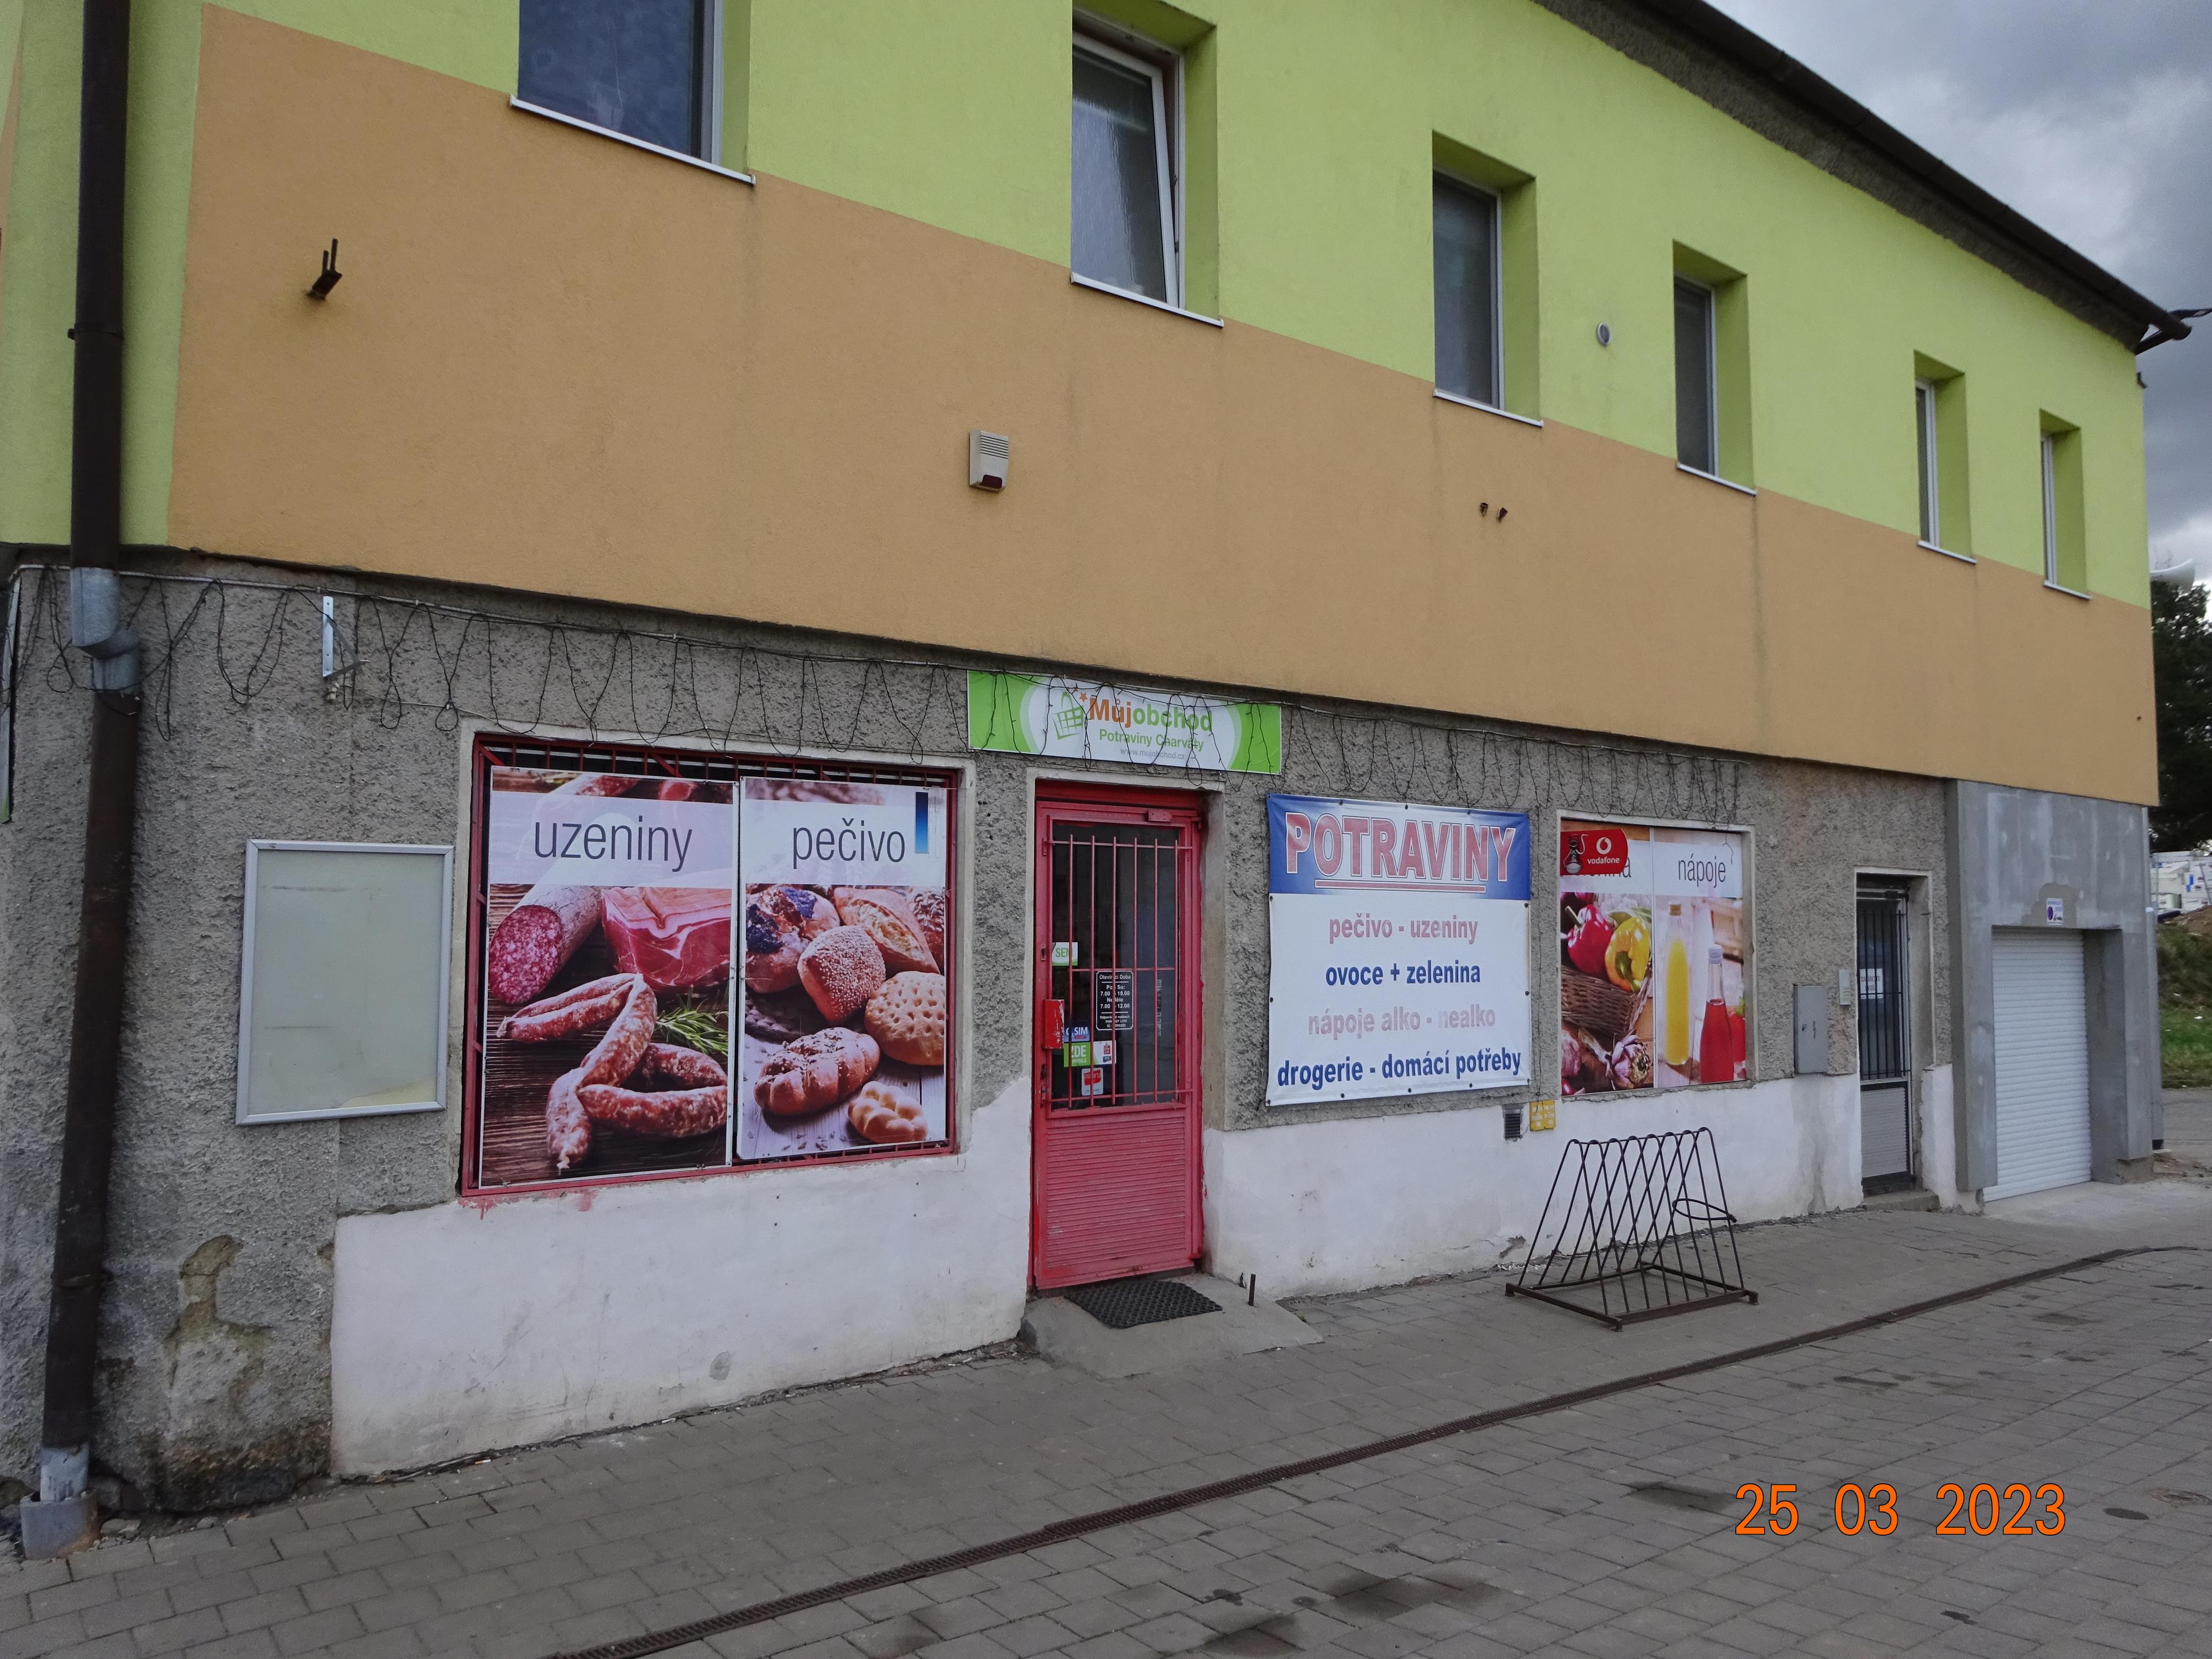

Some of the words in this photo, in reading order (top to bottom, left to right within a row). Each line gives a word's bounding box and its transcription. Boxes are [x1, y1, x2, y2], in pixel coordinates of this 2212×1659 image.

[1089, 697, 1213, 732] Můjobchod
[1099, 728, 1152, 747] Potraviny
[534, 815, 693, 873] uzeniny
[792, 817, 905, 870] pečivo
[1285, 811, 1517, 883] POTRAVINY
[1587, 855, 1620, 865] vodafone
[1677, 853, 1726, 888] nápoje
[1329, 912, 1393, 944] pečivo
[1410, 914, 1478, 945] uzeniny
[1325, 966, 1384, 986] ovoce
[1390, 962, 1400, 982] +
[1406, 959, 1481, 984] zelenina
[1074, 1026, 1088, 1035] SIM
[1308, 1008, 1375, 1041] nápoje
[1380, 1005, 1421, 1031] alko
[1438, 1003, 1496, 1029] nealko
[1277, 1056, 1364, 1091] drogerie
[1381, 1049, 1450, 1079] domácí
[1455, 1047, 1521, 1079] potřeby
